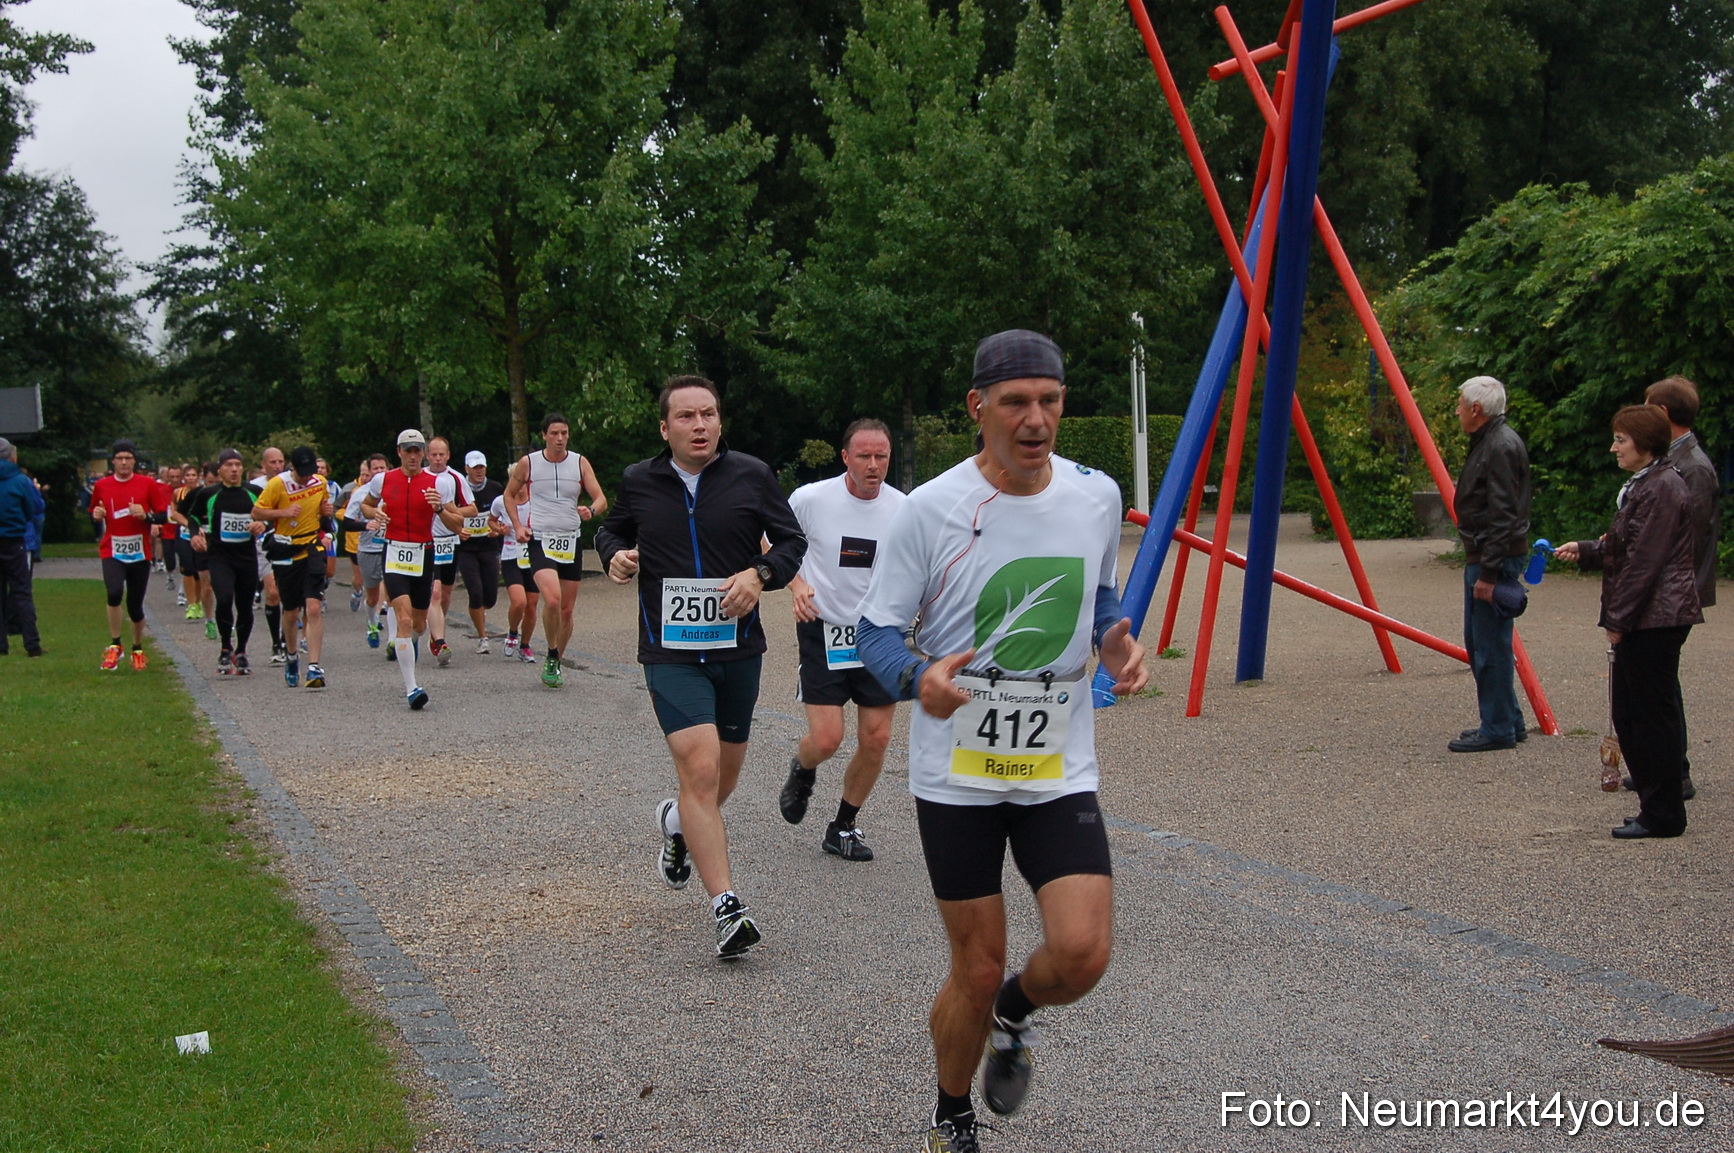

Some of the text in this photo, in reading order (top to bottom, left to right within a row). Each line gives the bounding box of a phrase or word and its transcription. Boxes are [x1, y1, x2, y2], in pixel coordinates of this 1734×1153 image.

[469, 518, 486, 528] 237
[115, 541, 140, 554] 2290
[548, 538, 569, 551] 289
[398, 550, 413, 562] 60
[664, 585, 689, 593] PARTL
[681, 628, 720, 640] Andreas
[998, 691, 1054, 705] Neumarkt
[976, 707, 1049, 749] 412
[985, 757, 1035, 777] Rainer
